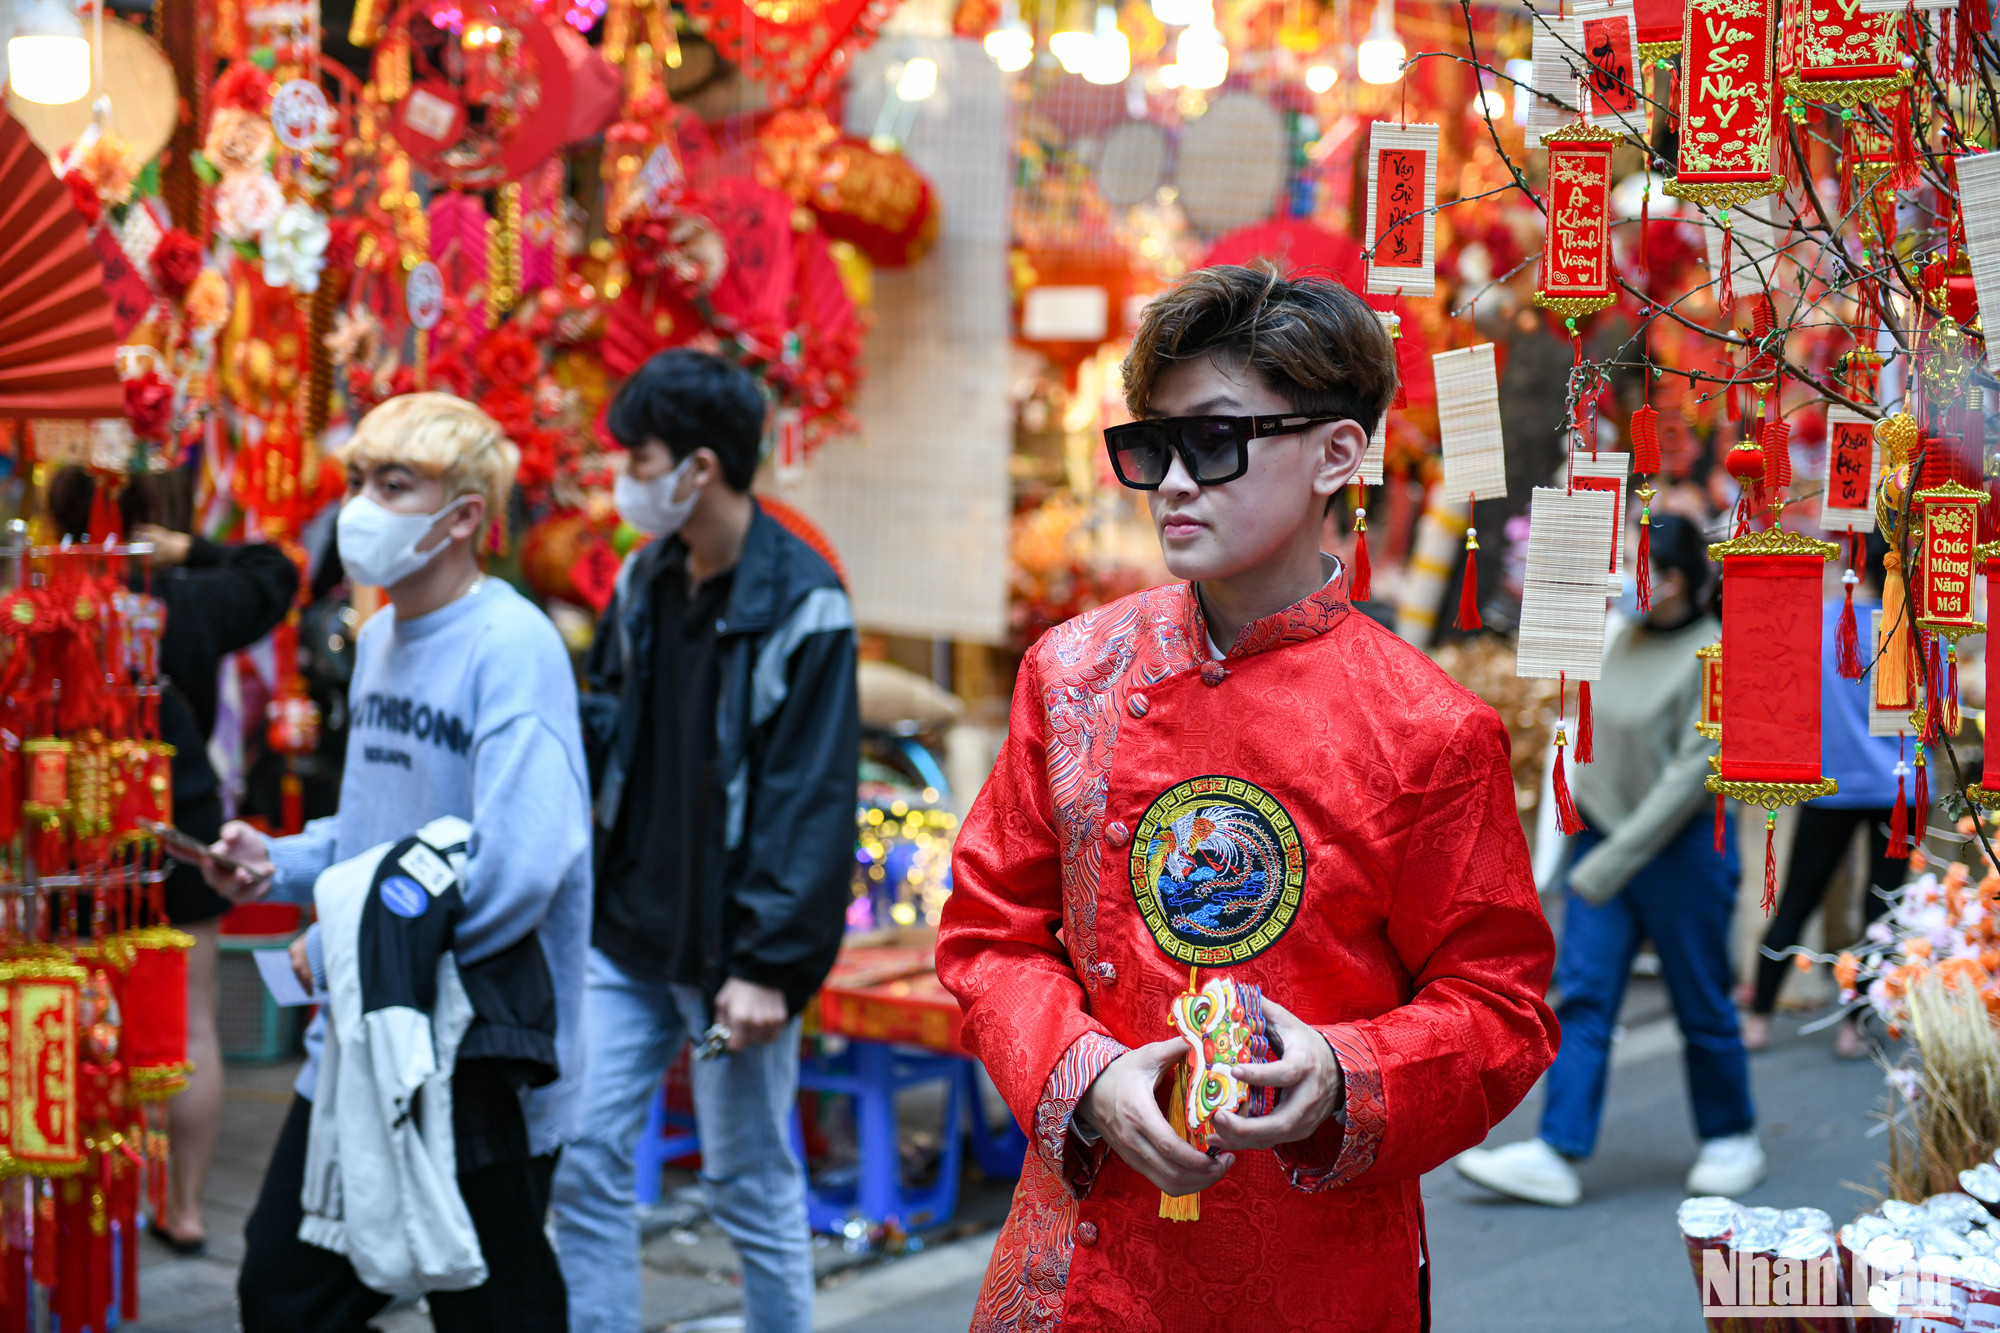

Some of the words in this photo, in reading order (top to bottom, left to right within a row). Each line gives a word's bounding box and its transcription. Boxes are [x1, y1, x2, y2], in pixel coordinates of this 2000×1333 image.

[1705, 16, 1755, 44] Vạn
[1705, 46, 1750, 73] Sự
[1699, 73, 1758, 103] Như
[1712, 98, 1740, 128] Ý
[1568, 186, 1591, 208] An
[1556, 208, 1602, 243] Khang
[1557, 229, 1599, 250] Thịnh
[1558, 249, 1598, 284] Vượng
[1933, 537, 1969, 555] Chúc
[1930, 556, 1970, 578] Mừng
[1933, 577, 1965, 594] Năm
[1936, 595, 1962, 613] Mới
